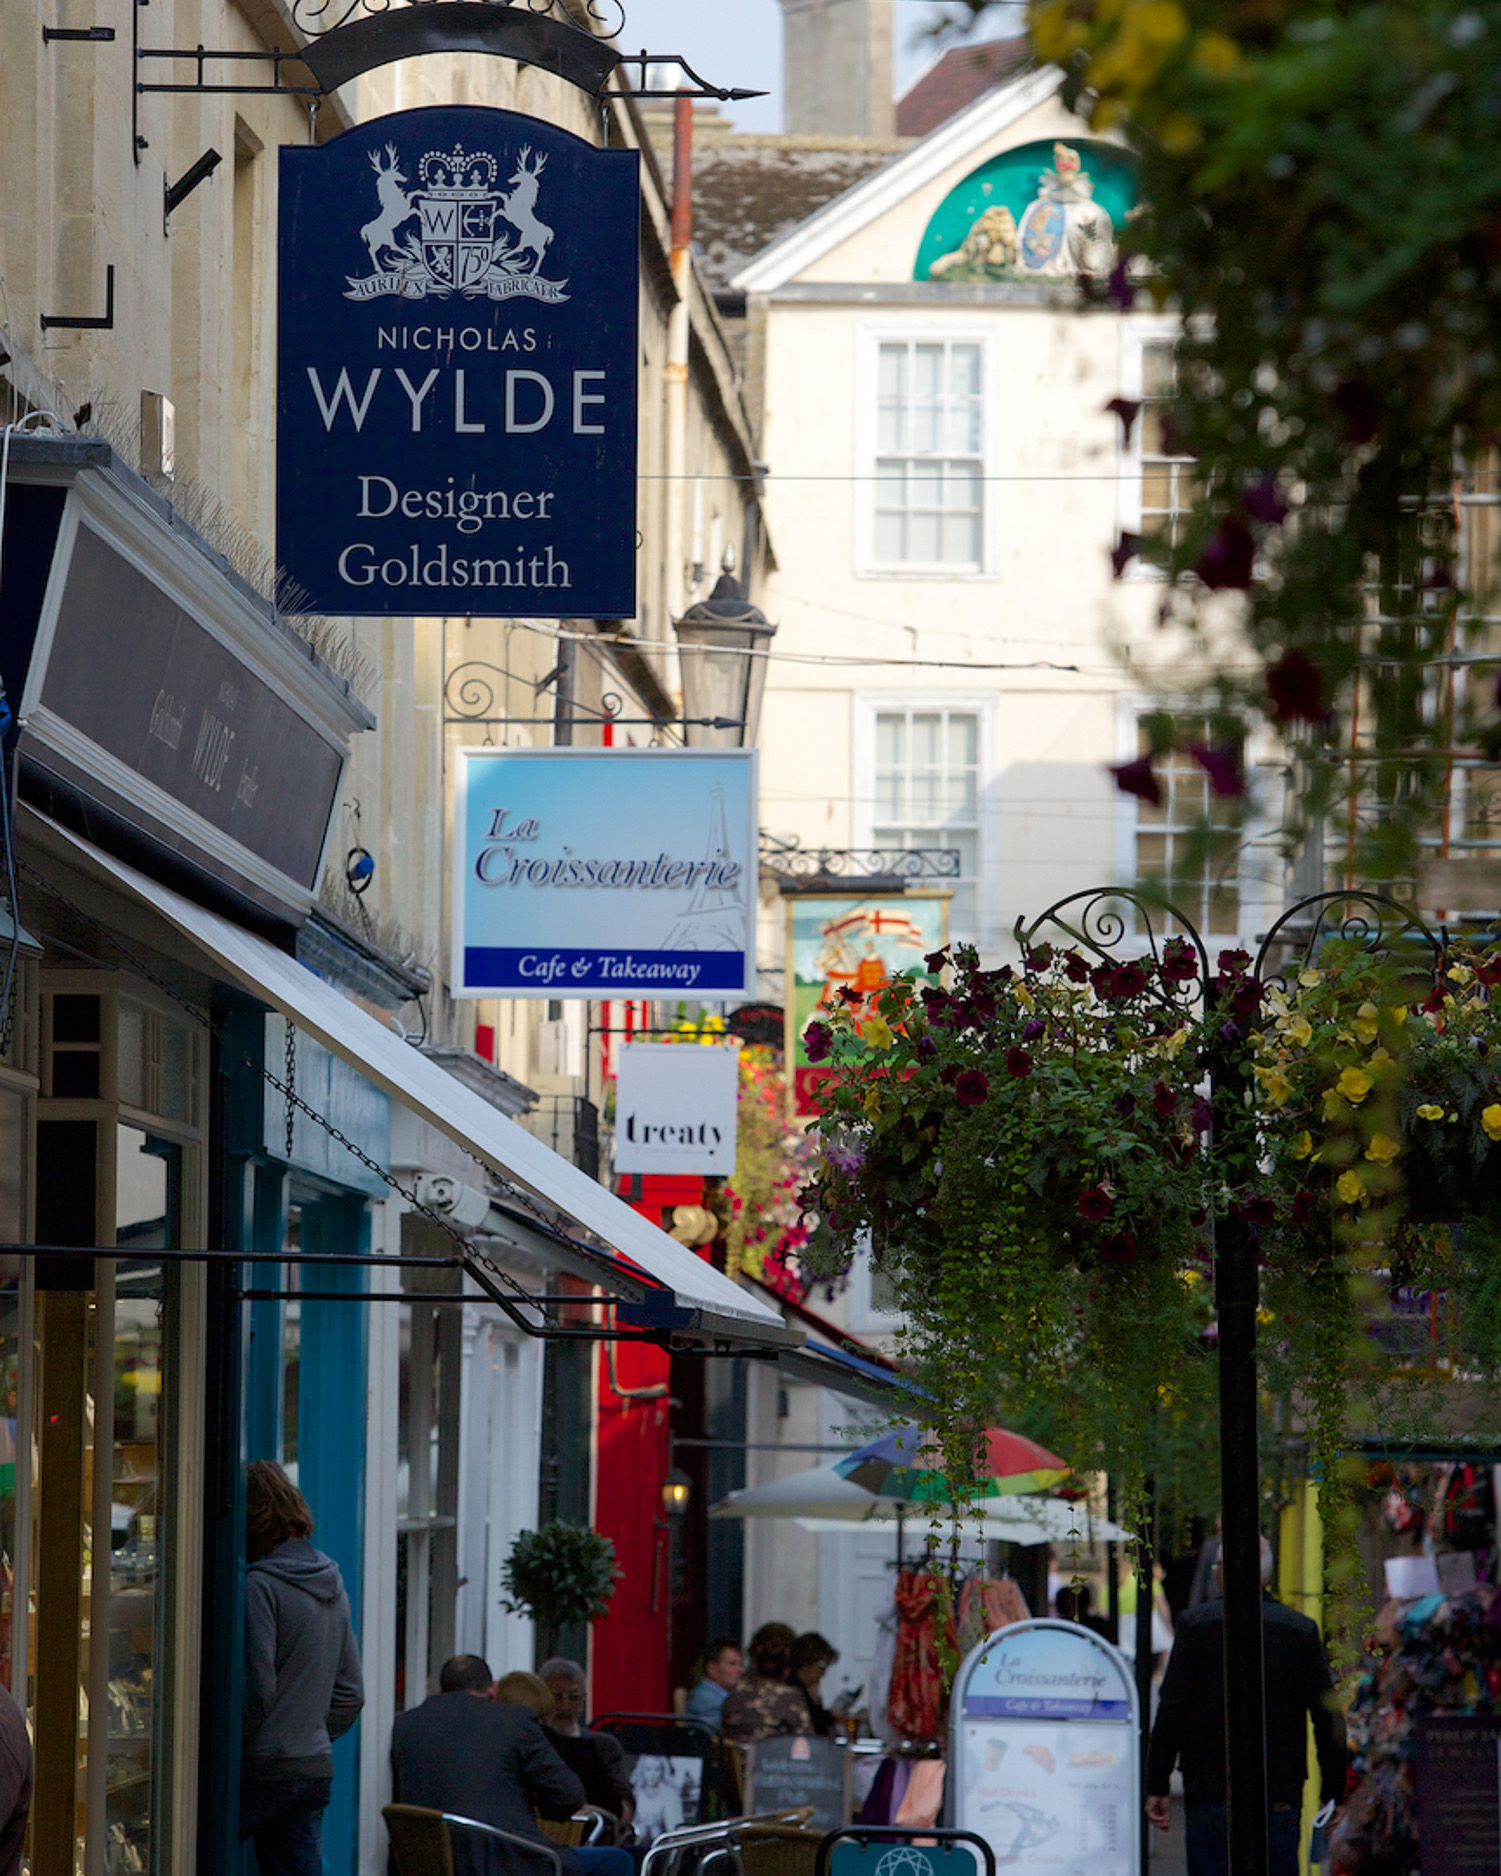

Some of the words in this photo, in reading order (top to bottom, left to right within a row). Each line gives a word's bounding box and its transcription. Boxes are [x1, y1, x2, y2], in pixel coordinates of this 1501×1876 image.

[425, 209, 454, 234] W
[377, 326, 537, 352] NICHOLAS
[306, 366, 606, 435] WYLDE
[355, 475, 555, 534] Designer
[337, 543, 573, 589] Goldsmith
[485, 807, 539, 841] La
[474, 845, 742, 889] Croissanterie
[518, 954, 567, 984] Cafe
[570, 957, 592, 978] &
[598, 956, 701, 985] Takeaway
[625, 1110, 724, 1156] treaty
[1000, 1653, 1021, 1667] La
[994, 1668, 1106, 1690] Croissanterie
